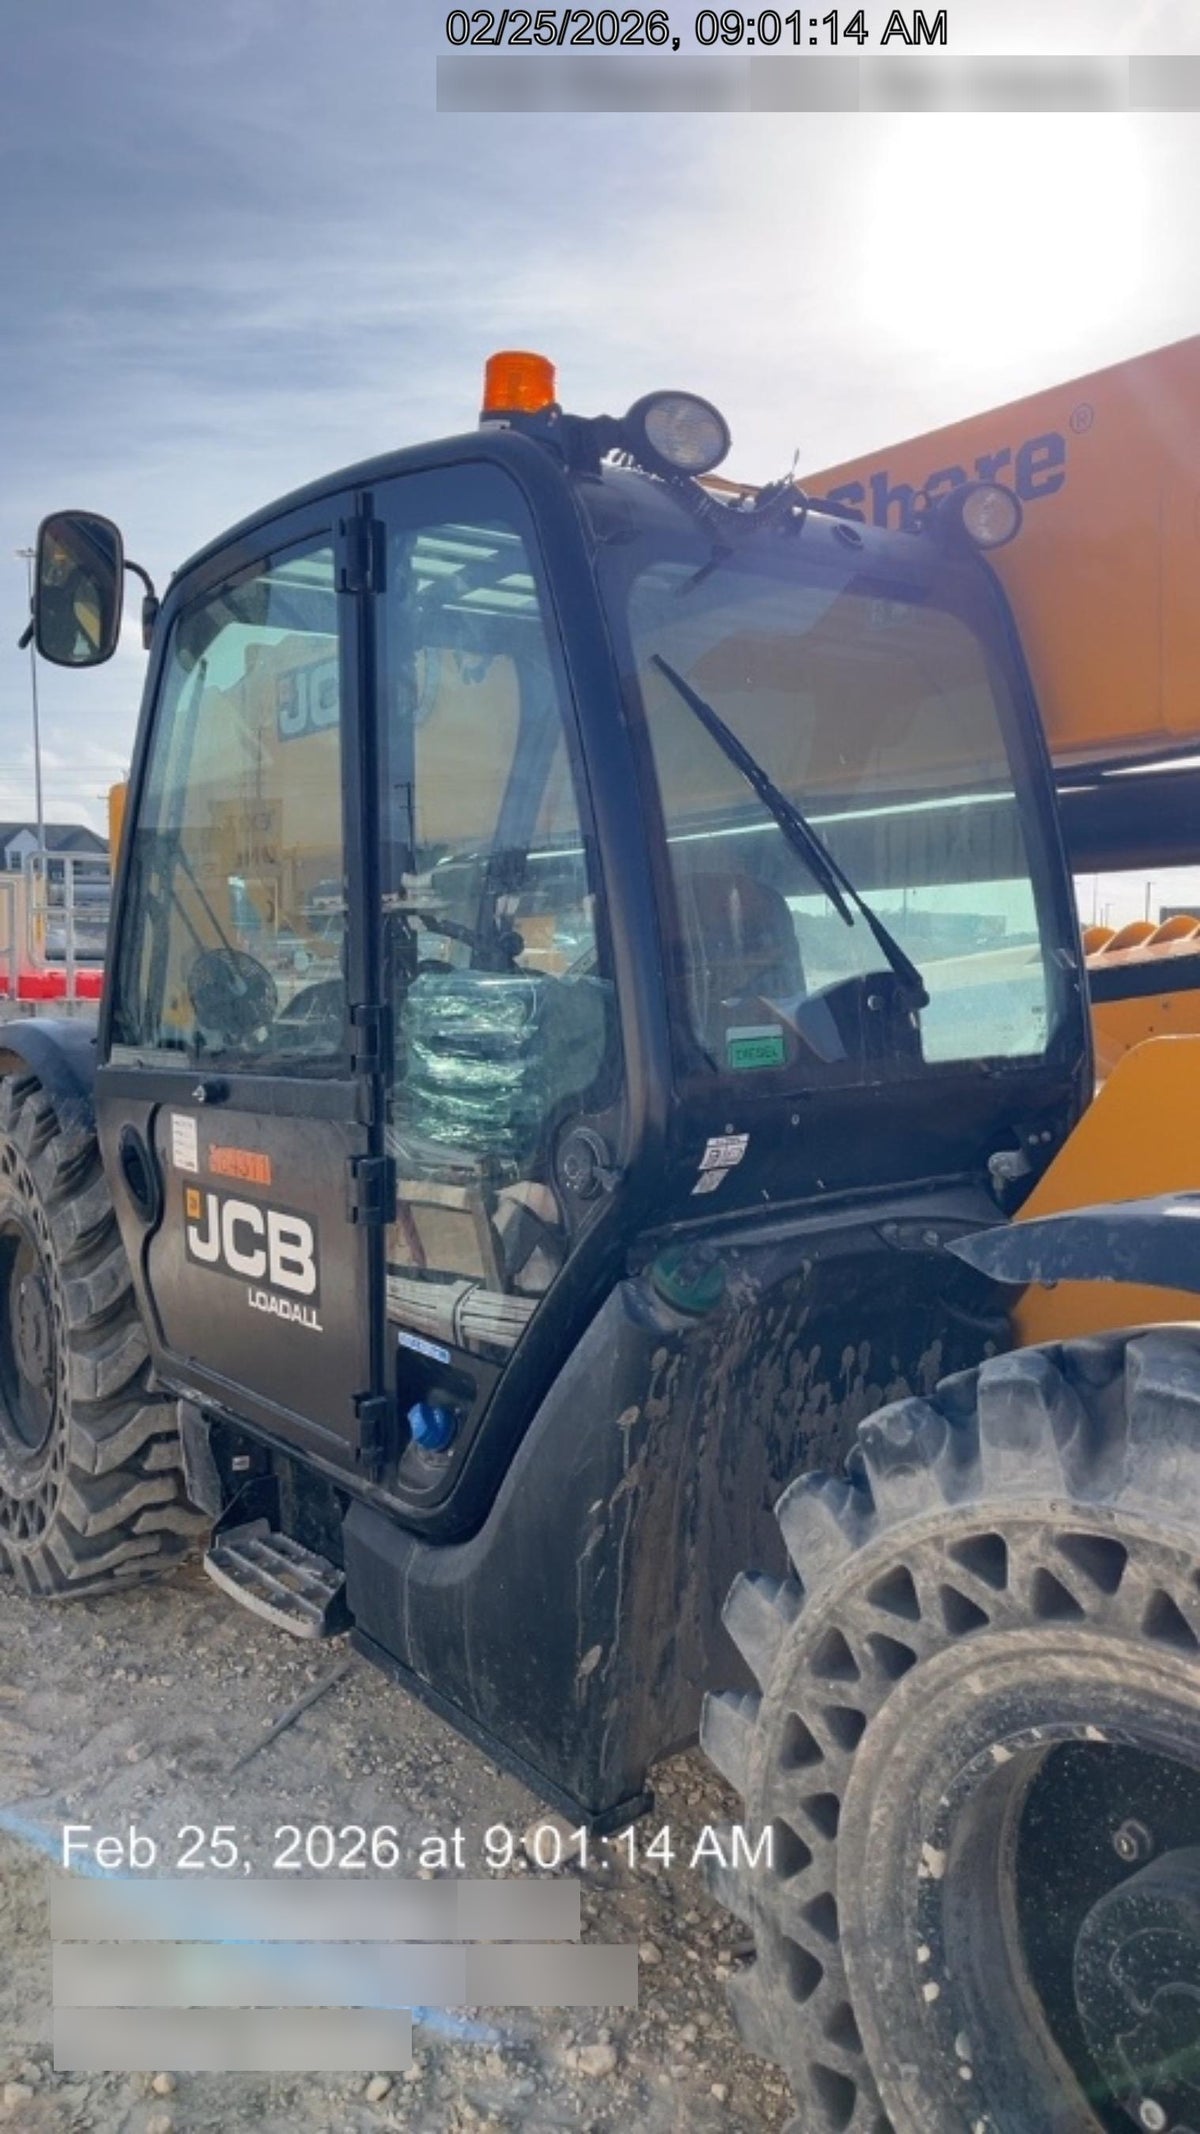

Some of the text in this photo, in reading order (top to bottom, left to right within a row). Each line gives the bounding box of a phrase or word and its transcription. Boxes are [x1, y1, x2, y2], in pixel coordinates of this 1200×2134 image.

[279, 660, 341, 735] JC
[188, 1194, 318, 1296] JCB
[248, 1287, 324, 1333] LOADALL
